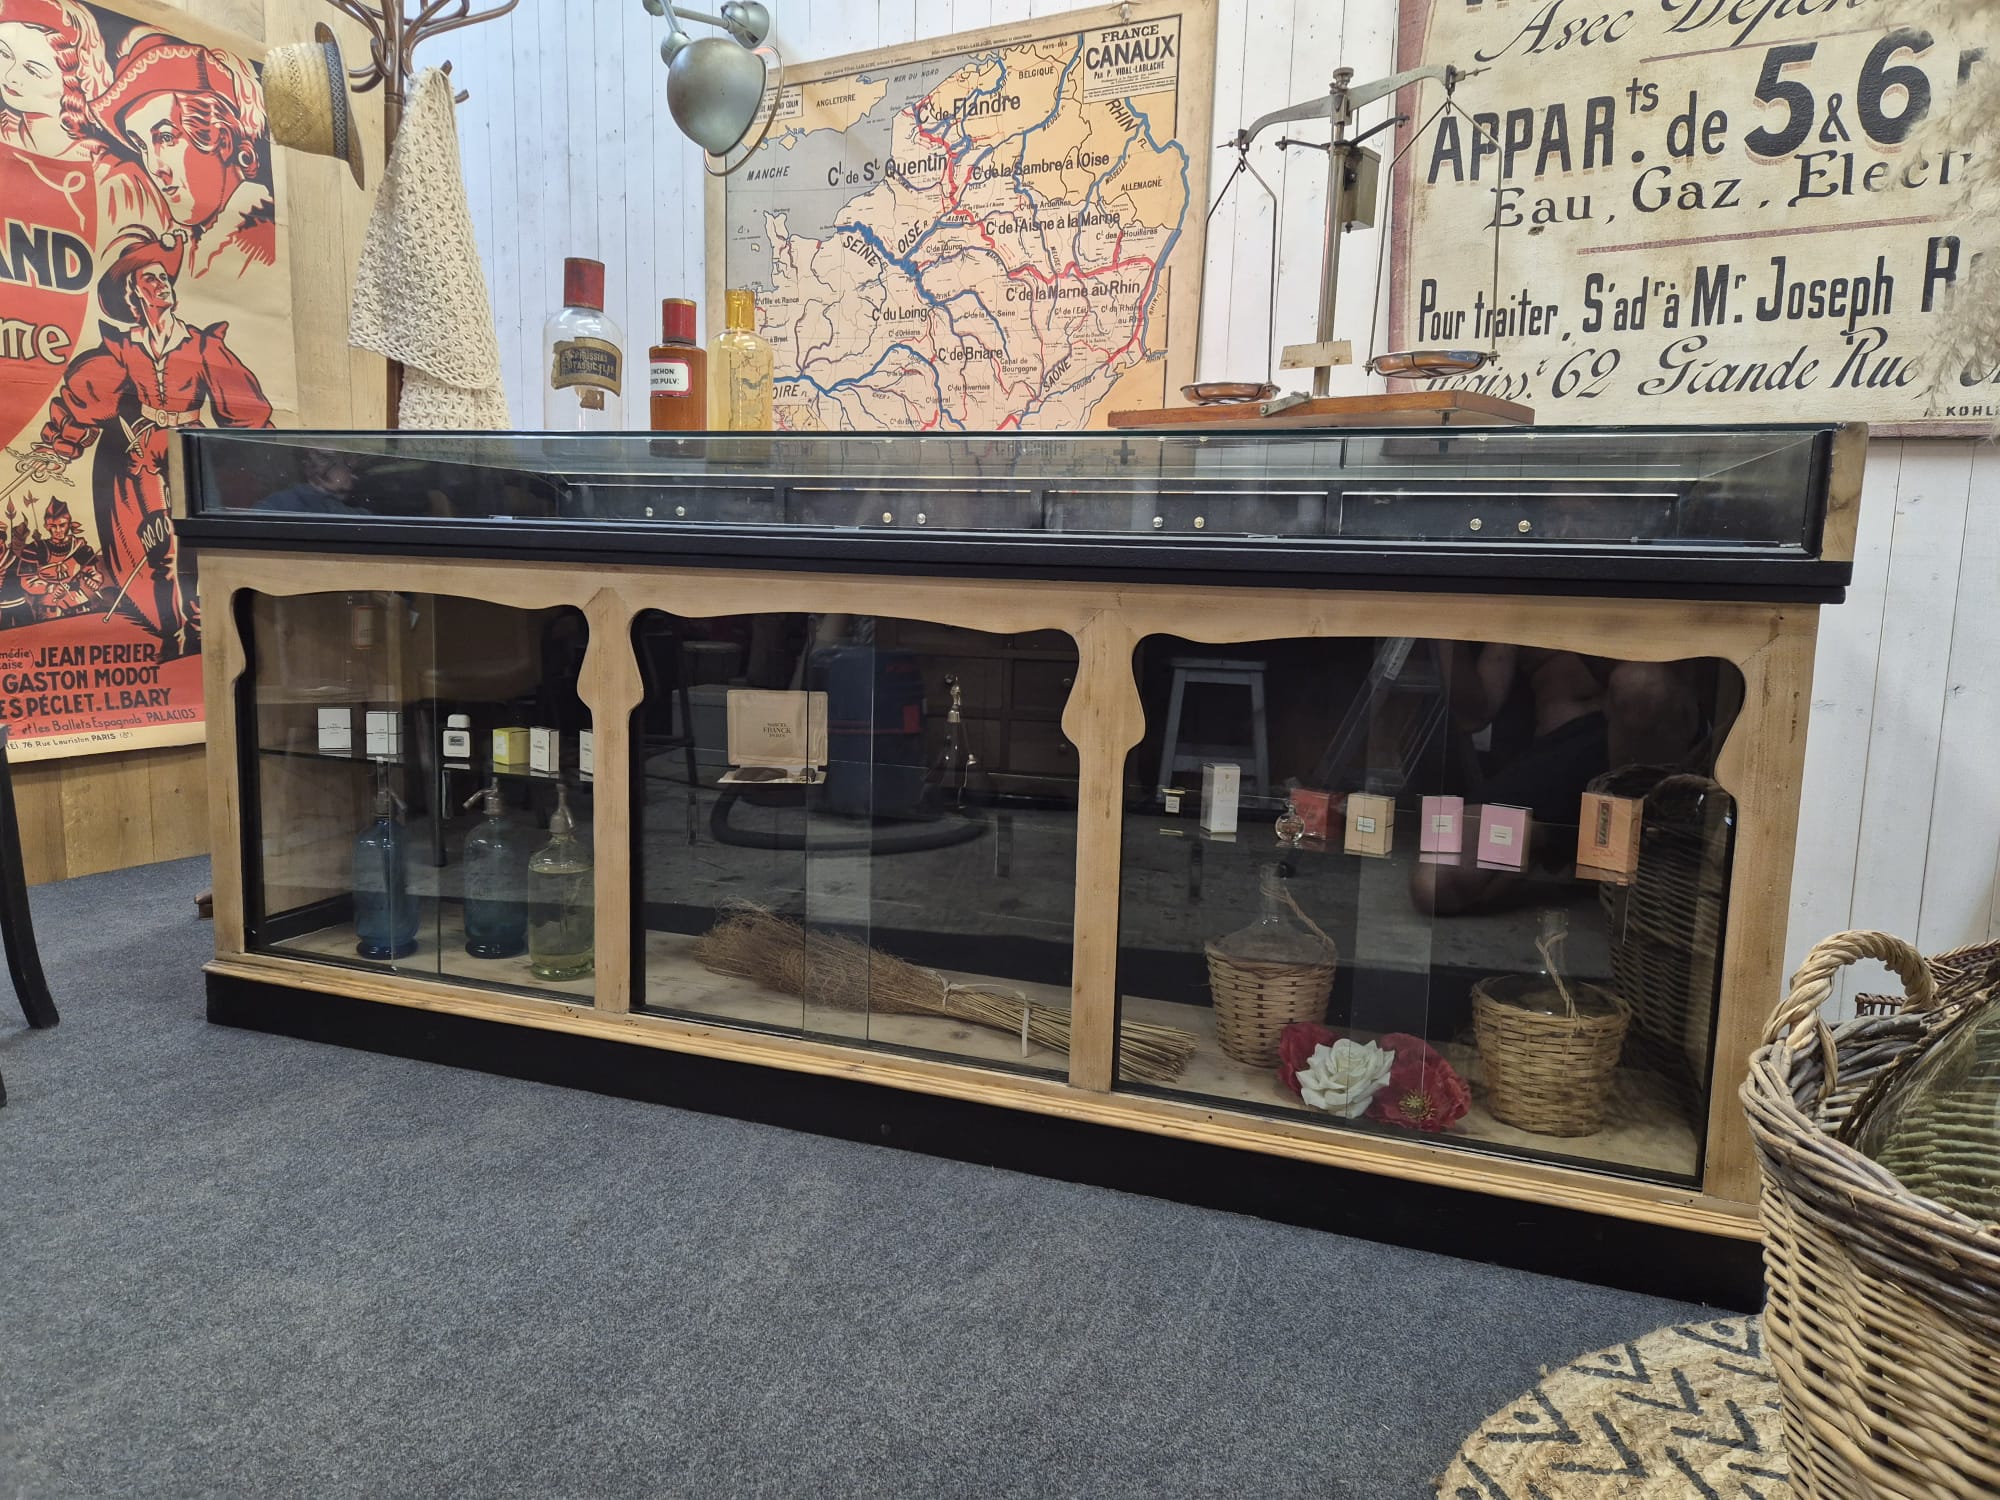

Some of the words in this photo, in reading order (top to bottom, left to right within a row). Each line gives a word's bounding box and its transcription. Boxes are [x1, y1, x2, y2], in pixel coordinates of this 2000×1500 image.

[1101, 24, 1160, 44] FRANCE
[1085, 34, 1176, 70] CANAUX
[893, 73, 907, 83] MER
[908, 72, 918, 81] DU
[921, 67, 940, 77] NORD
[1018, 65, 1055, 80] BELGIQUE
[815, 93, 857, 108] ANGLETERRE
[953, 94, 1021, 120] Flandre
[1105, 98, 1139, 132] RHIN
[1666, 90, 1728, 157] de
[747, 165, 791, 182] MANCHE
[845, 171, 860, 185] de
[884, 152, 949, 178] Quentin
[1001, 163, 1012, 177] la
[1014, 159, 1062, 176] Sambre
[1065, 155, 1074, 169] à
[1076, 152, 1110, 169] l'Oise
[1120, 178, 1163, 192] ALLEMAGNE
[998, 220, 1013, 234] de
[1056, 216, 1065, 228] à
[1067, 213, 1079, 229] la
[1081, 211, 1121, 227] Marne
[897, 219, 924, 254] OISE
[842, 235, 879, 268] SEINE
[1018, 286, 1033, 301] de
[1035, 285, 1047, 300] la
[1047, 283, 1088, 299] Marne
[1091, 284, 1108, 296] au
[1109, 279, 1140, 295] Rhin
[1418, 278, 1466, 343] Pour
[1756, 255, 1895, 346] Joseph
[883, 307, 897, 320] du
[899, 304, 928, 322] Loing
[949, 347, 963, 361] de
[965, 345, 1003, 360] Briare
[1001, 365, 1038, 374] Bourgogne
[1551, 347, 1621, 399] 62
[34, 645, 86, 669] JEAN
[89, 643, 157, 665] PERIER
[2, 669, 89, 695] GASTON
[94, 665, 160, 689] MODOT
[52, 718, 91, 732] Ballets
[91, 713, 142, 730] Espagnols
[22, 741, 33, 749] 76
[91, 732, 116, 742] PARIS
